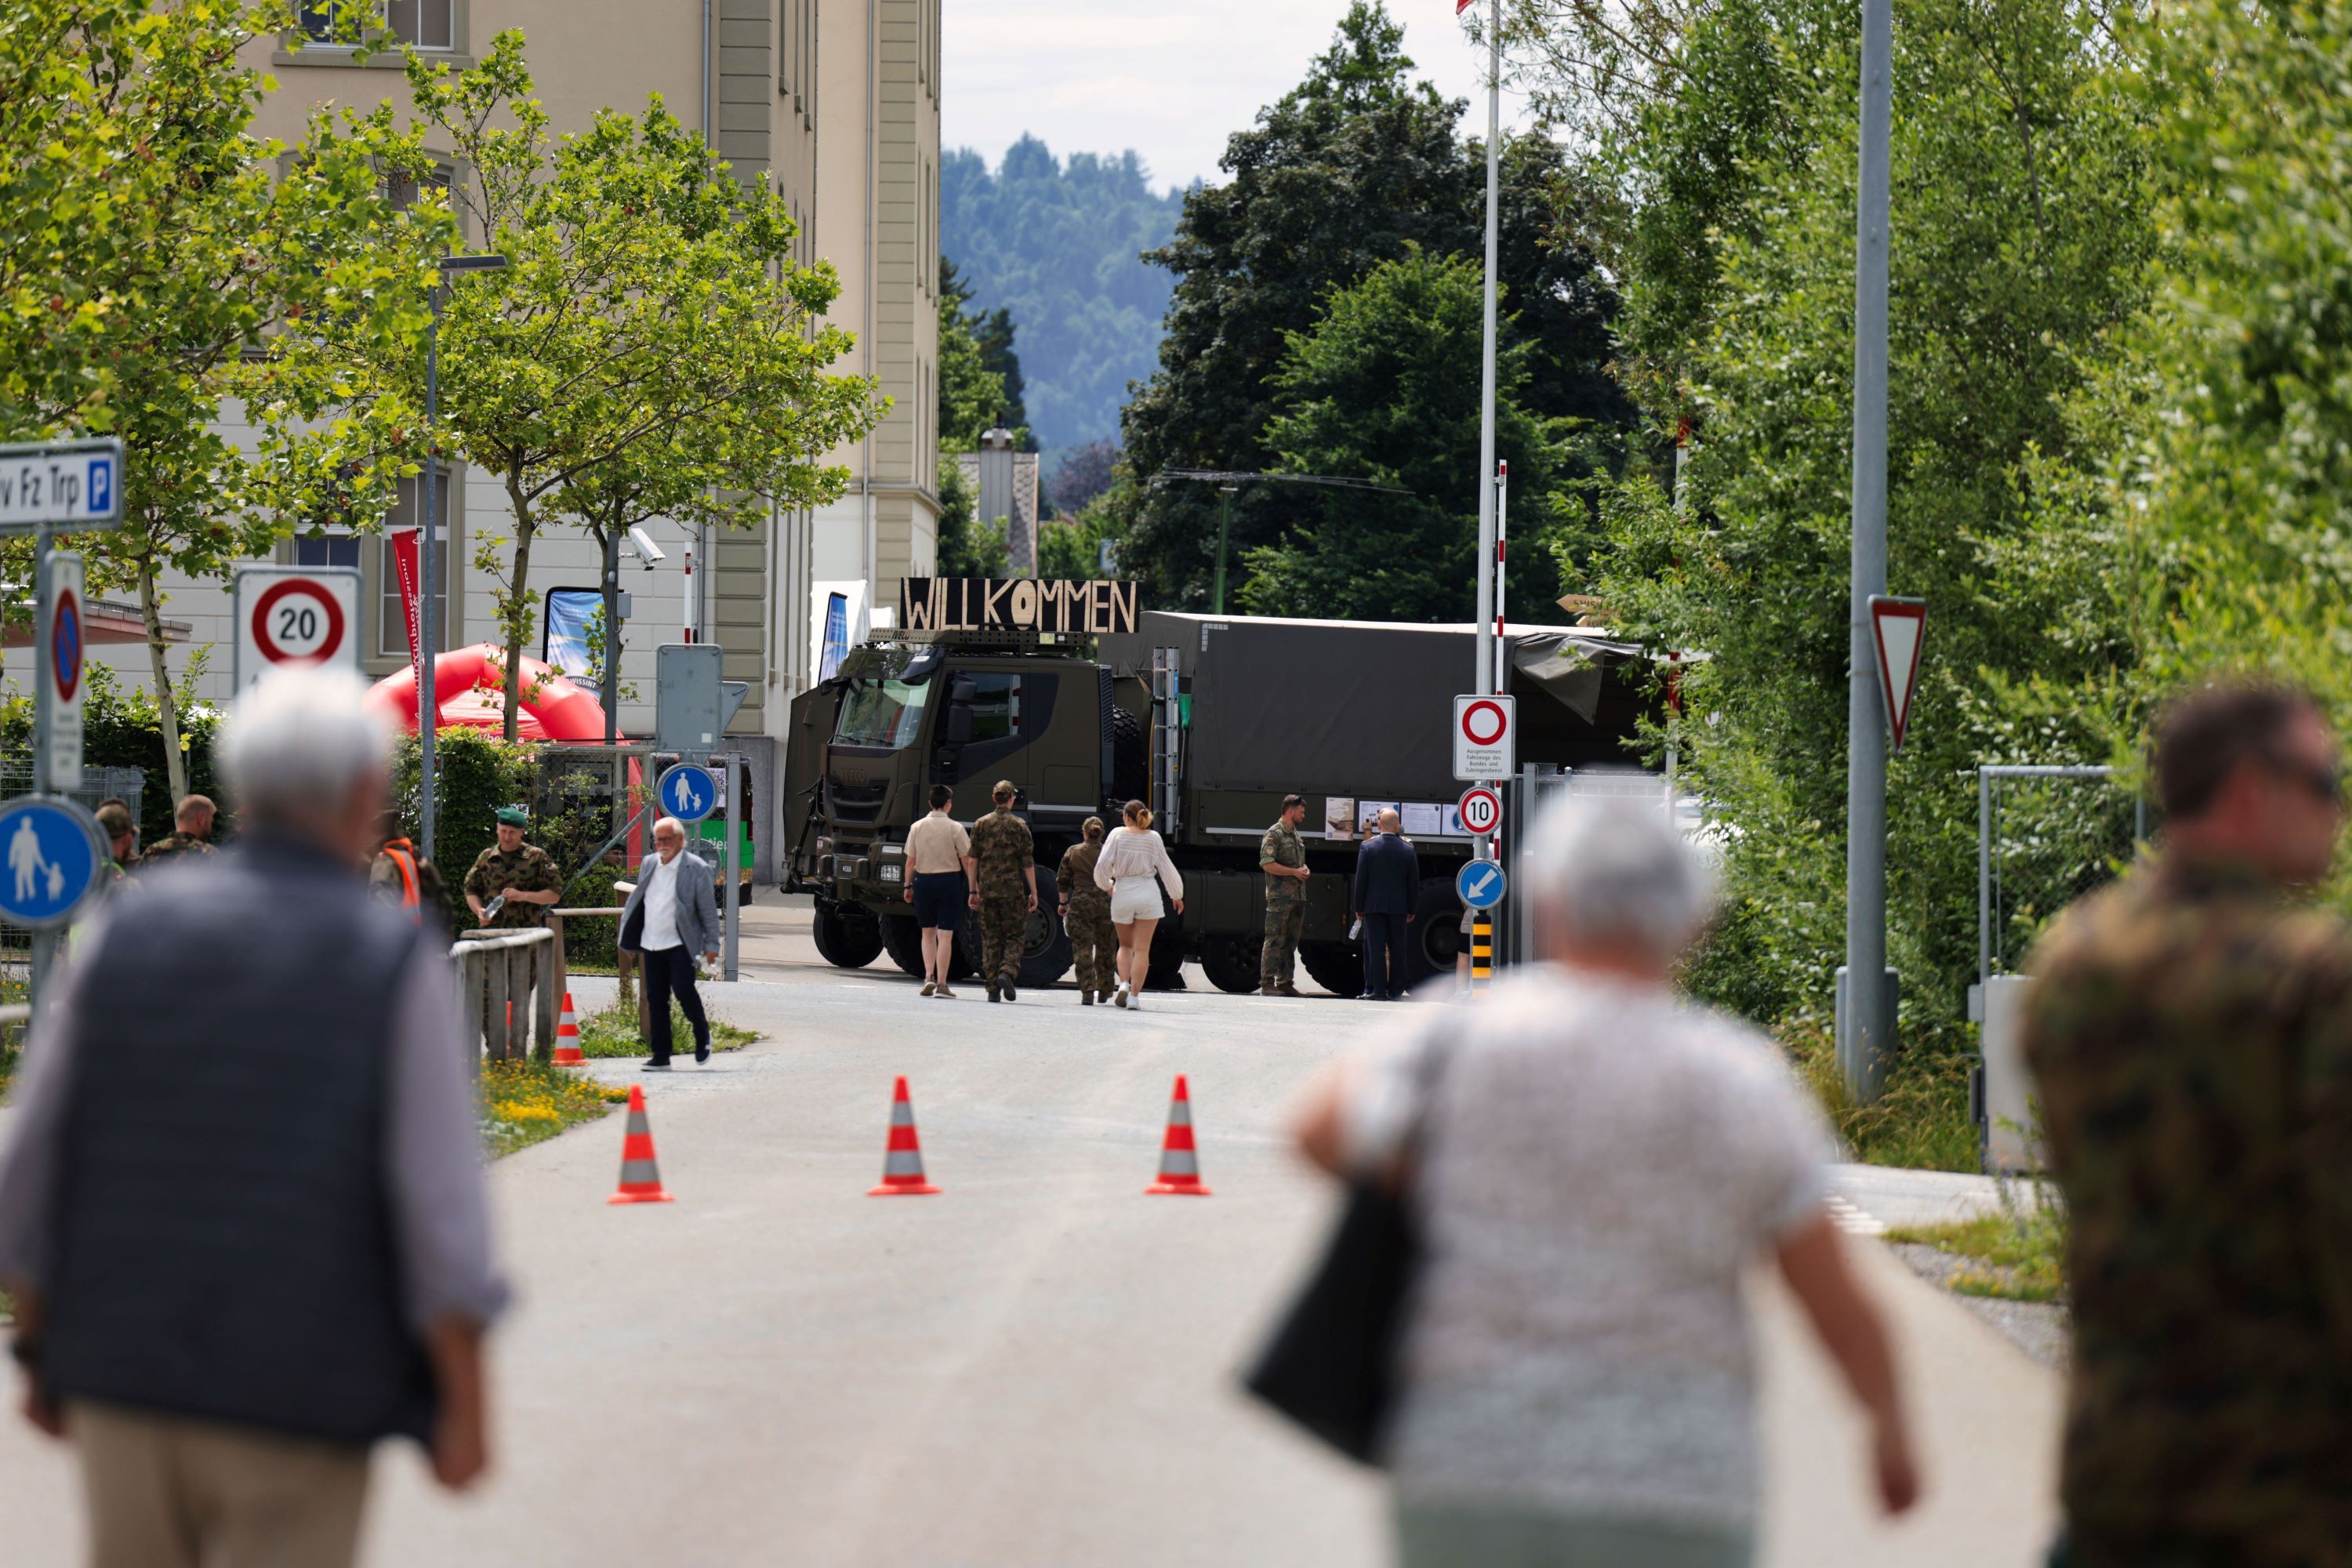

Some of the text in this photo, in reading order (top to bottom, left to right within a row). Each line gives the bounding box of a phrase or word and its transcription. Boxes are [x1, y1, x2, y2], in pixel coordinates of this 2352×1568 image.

[0, 477, 13, 506] v
[20, 466, 41, 506] Fz
[49, 464, 80, 515] Trp
[903, 577, 1137, 633] WILLKOMMEN
[280, 608, 316, 641] 20
[568, 677, 597, 688] WISSINT
[1471, 801, 1489, 821] 10
